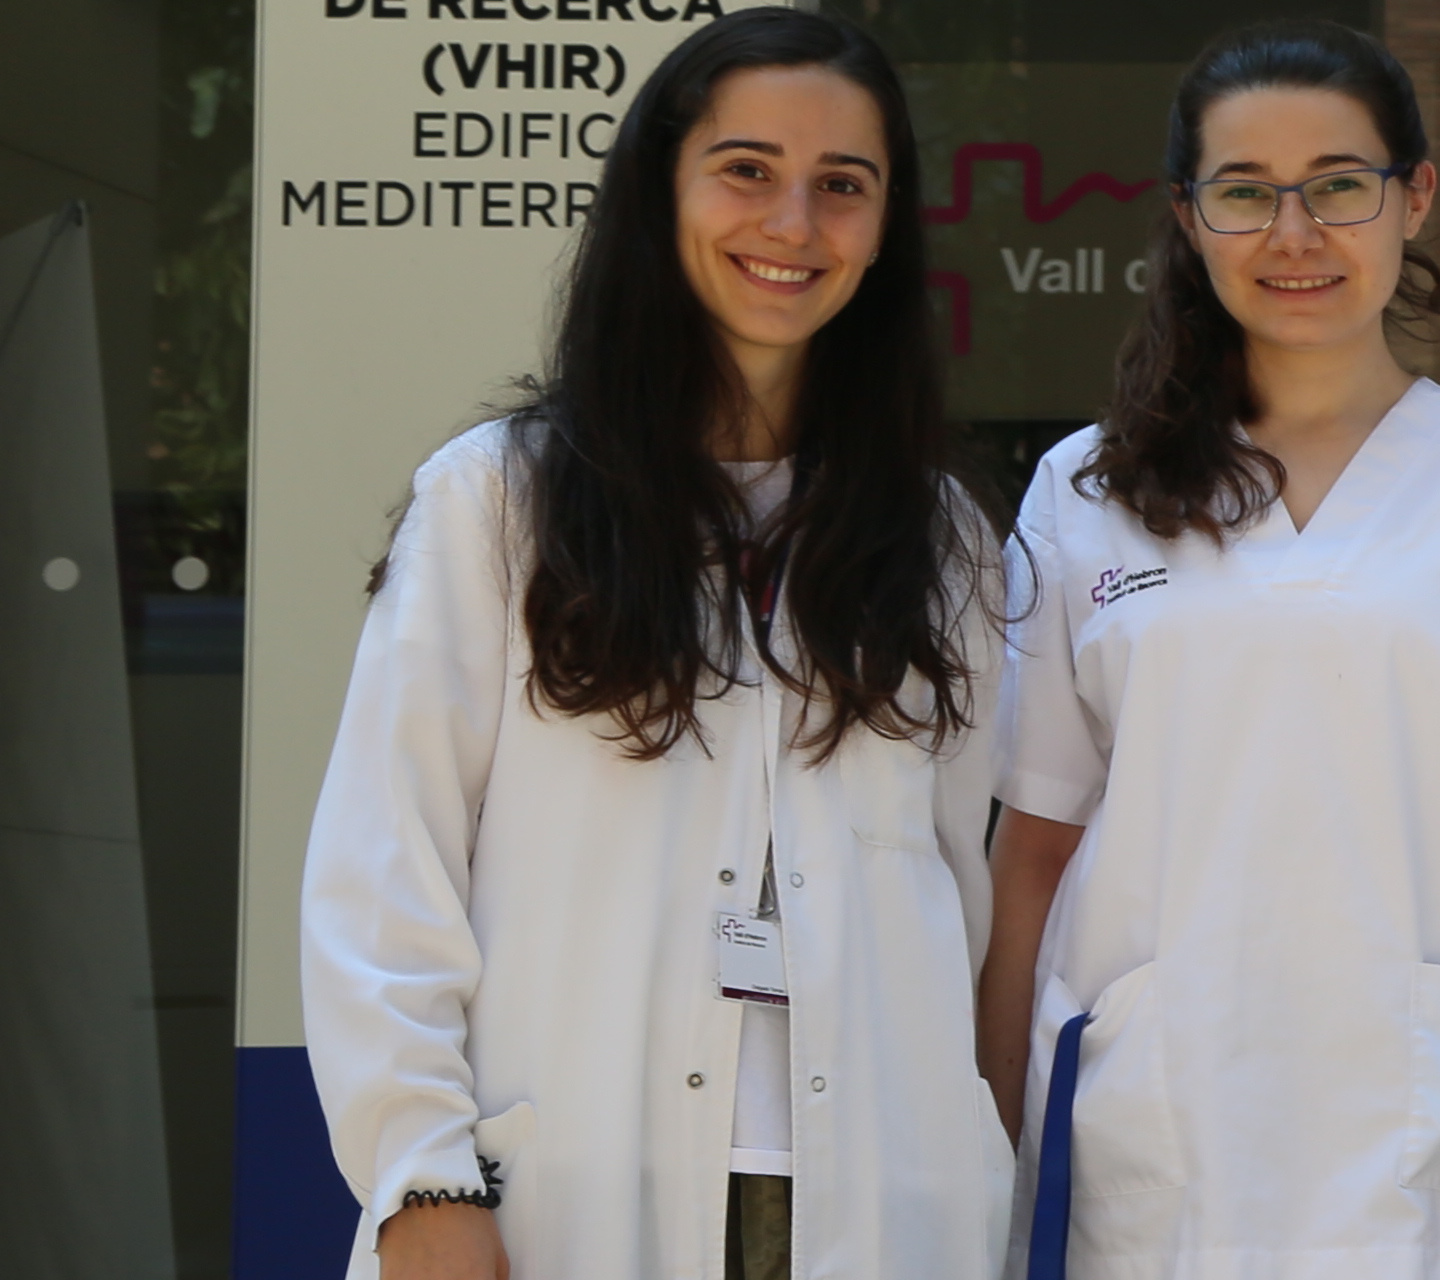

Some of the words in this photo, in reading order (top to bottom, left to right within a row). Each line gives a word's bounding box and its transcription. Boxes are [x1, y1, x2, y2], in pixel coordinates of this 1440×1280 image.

[422, 42, 626, 98] (VHIR)
[413, 111, 616, 159] EDIFIC
[282, 180, 600, 228] MEDITERR
[1001, 247, 1104, 294] Vall
